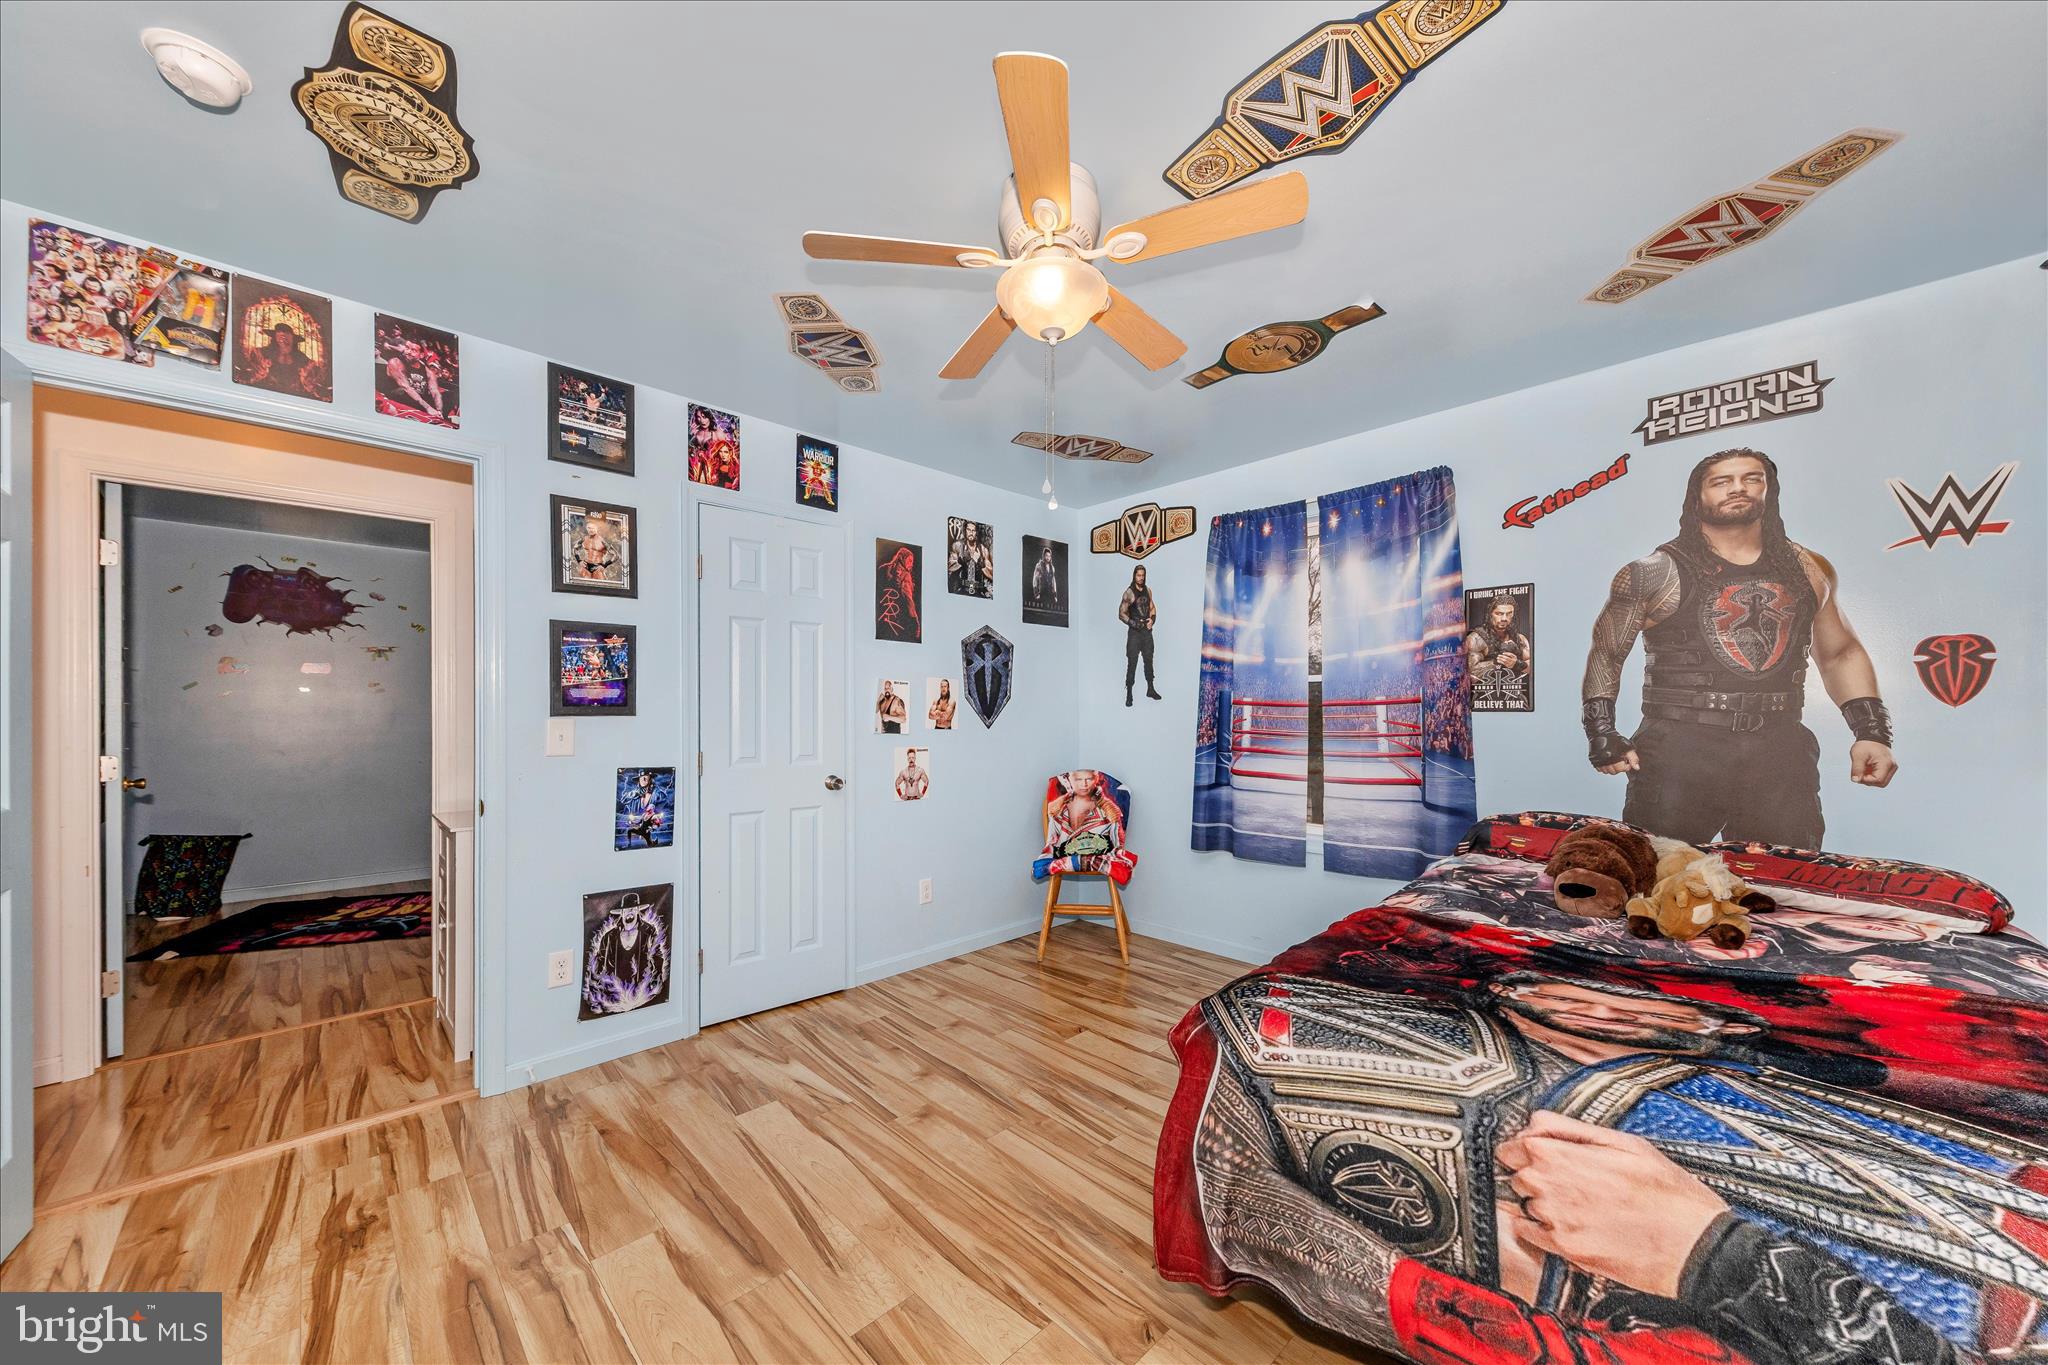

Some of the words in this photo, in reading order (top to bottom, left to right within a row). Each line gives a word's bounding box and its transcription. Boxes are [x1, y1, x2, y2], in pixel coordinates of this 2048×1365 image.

[1286, 134, 1341, 156] UNIVERSAL
[1344, 92, 1386, 133] CHAMPION
[1643, 384, 1821, 441] REIGNS
[1652, 365, 1816, 420] ROMAN
[802, 447, 835, 467] WARRIOR
[1503, 455, 1630, 528] Fathead
[1473, 589, 1494, 599] BRING
[1494, 587, 1508, 596] THE
[1509, 586, 1529, 595] FIGHT
[1474, 700, 1504, 709] BELIEVE
[1505, 700, 1525, 709] THAT
